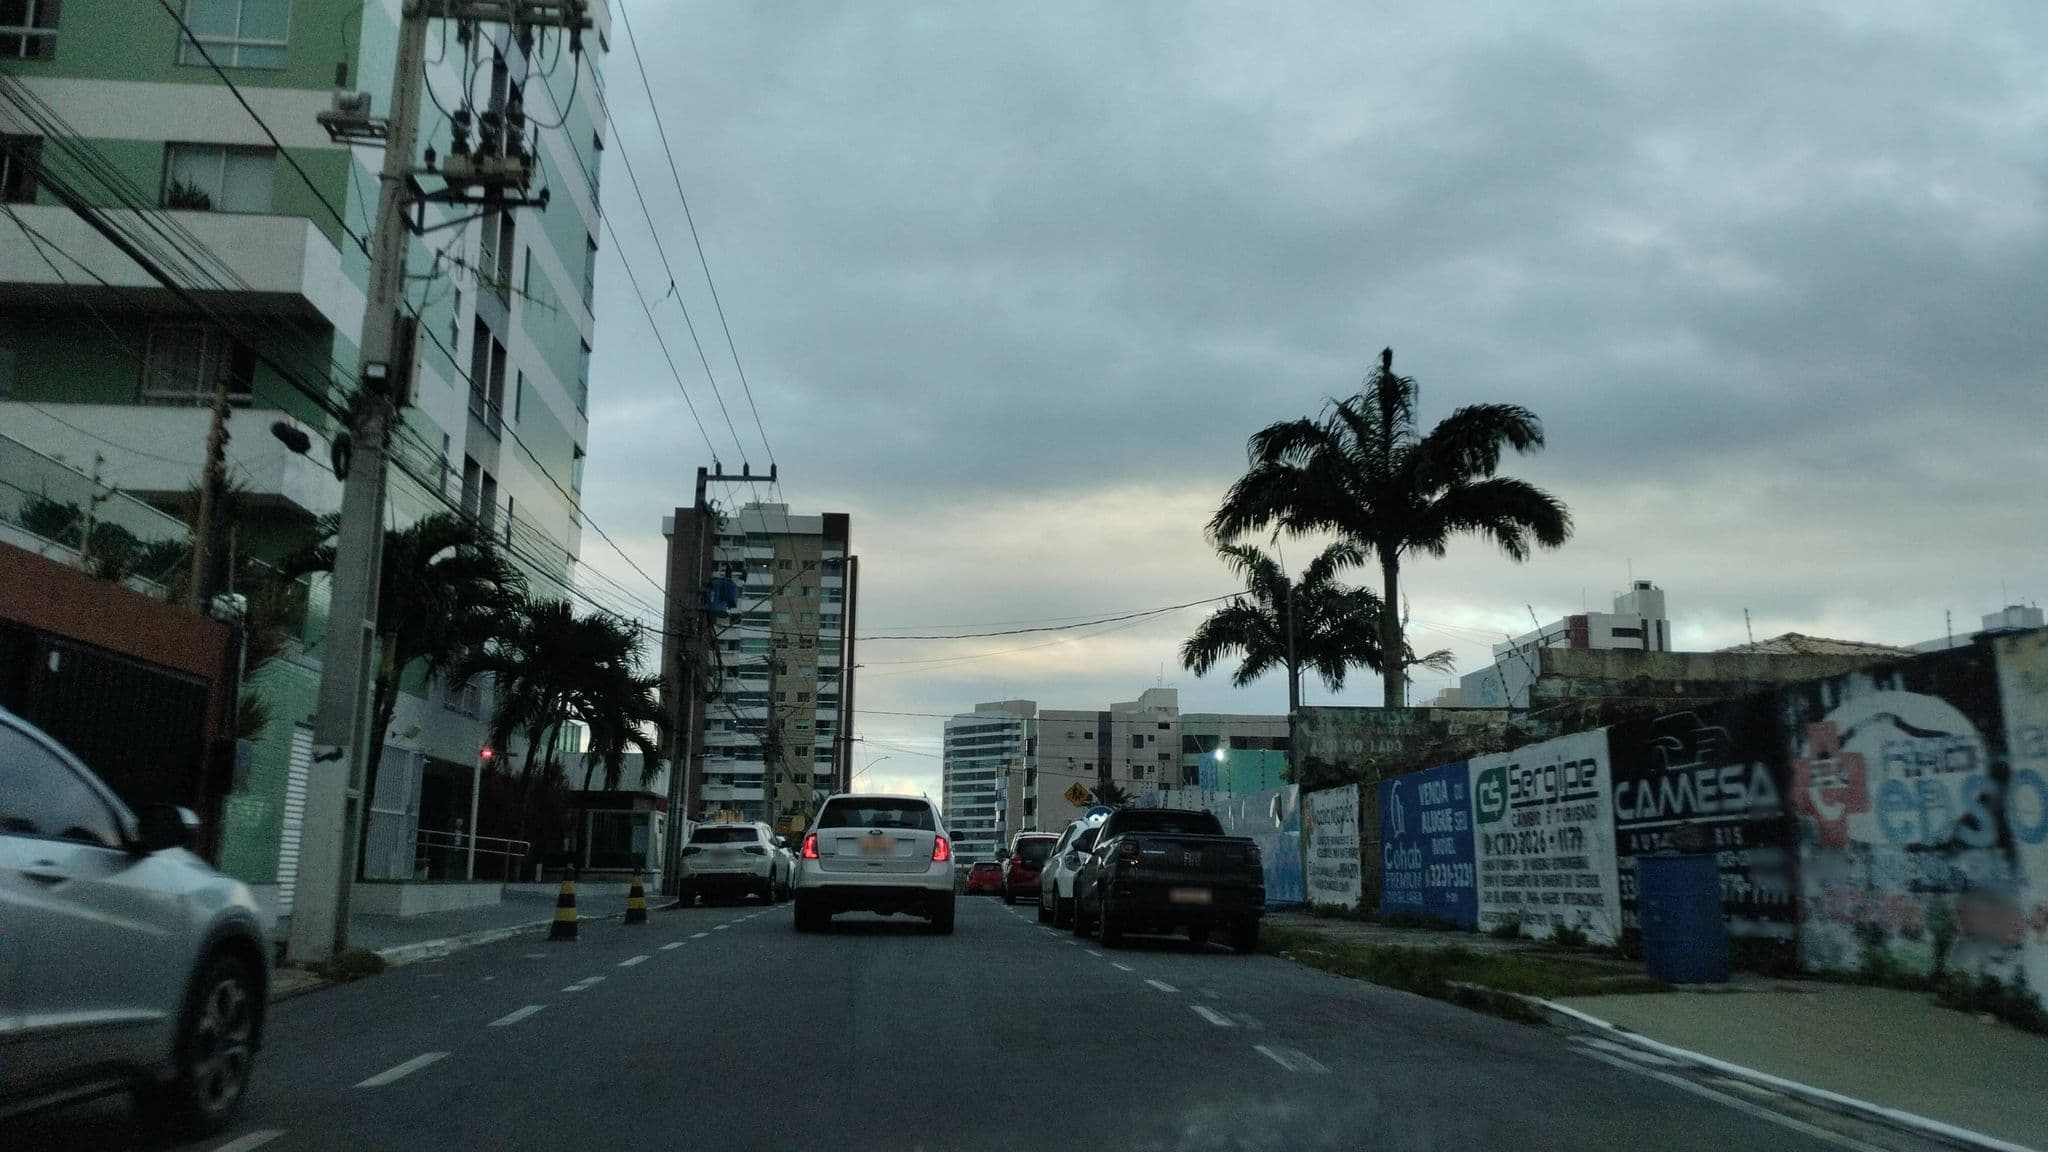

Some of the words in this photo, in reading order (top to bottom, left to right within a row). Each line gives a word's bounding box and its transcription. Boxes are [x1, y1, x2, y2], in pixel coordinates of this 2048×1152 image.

[1418, 779, 1448, 806] VENDA
[1509, 756, 1597, 802] Sergipe
[1615, 761, 1780, 820] CAMESA
[1384, 841, 1422, 870] Cohab
